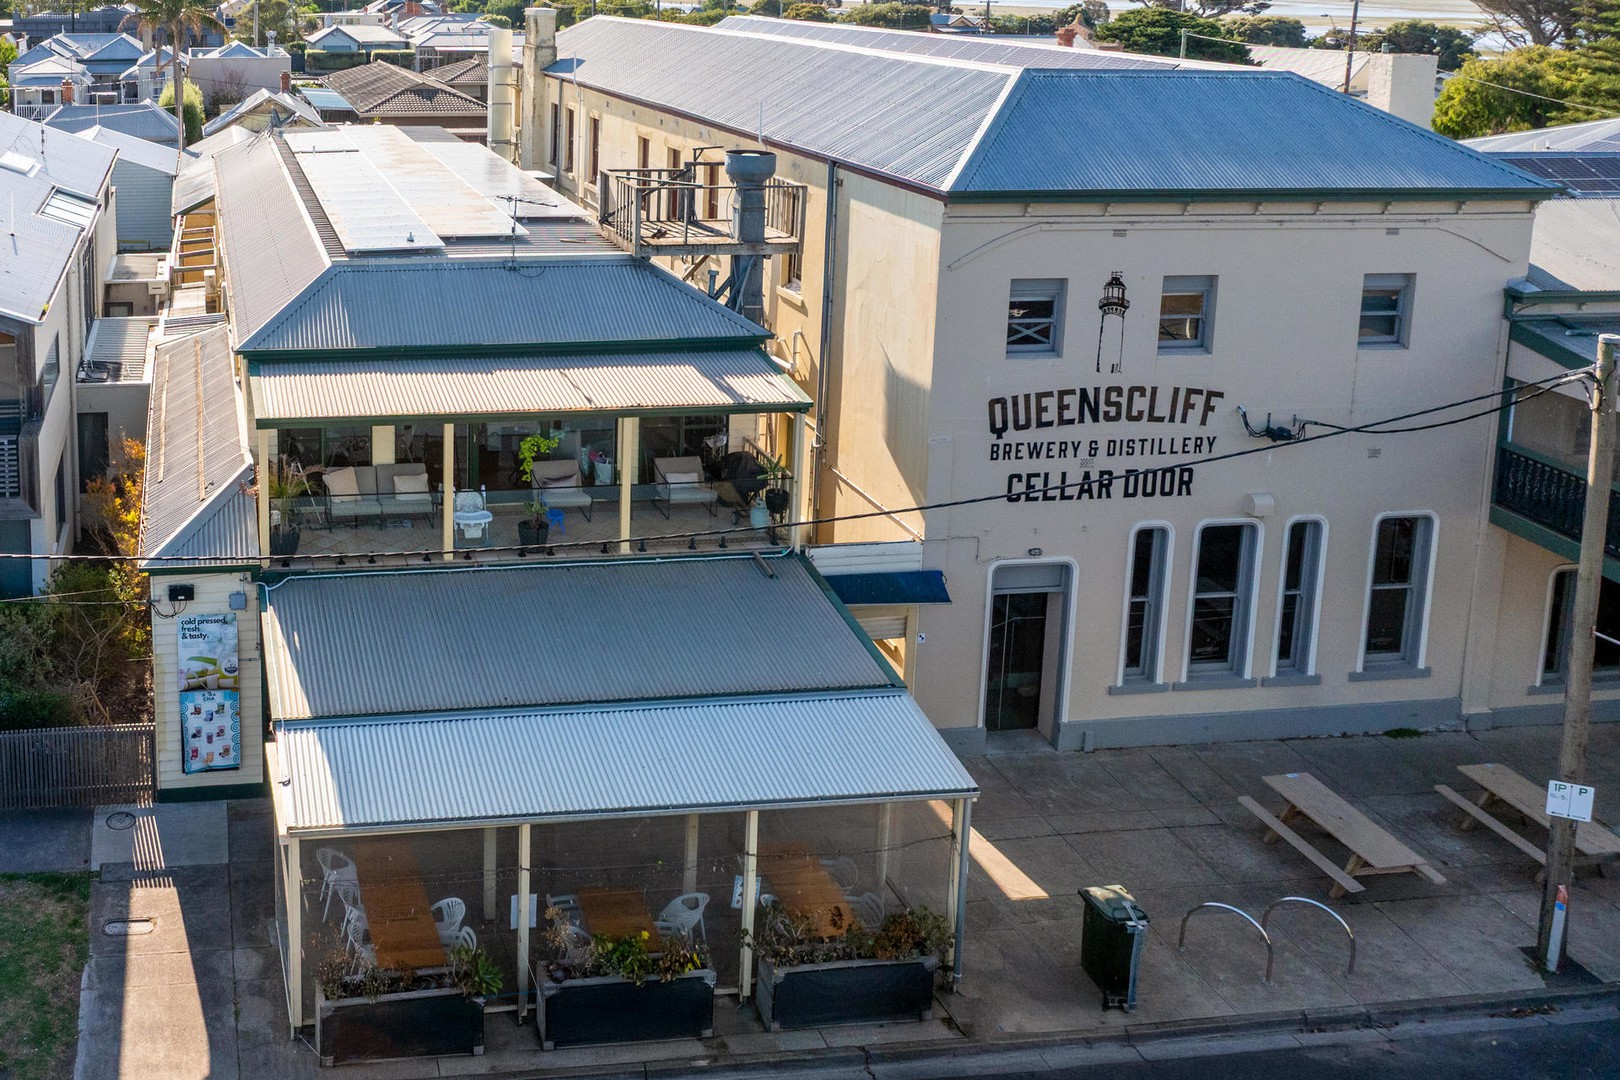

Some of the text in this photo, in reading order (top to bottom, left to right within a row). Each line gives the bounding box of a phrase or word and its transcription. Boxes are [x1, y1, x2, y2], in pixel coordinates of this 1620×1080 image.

[988, 386, 1224, 440] QUEENSCLIFF
[989, 435, 1217, 461] BREWERY & DISTILLERY
[1006, 467, 1194, 503] CELLAR DOOR
[181, 632, 209, 641] & tasty.
[1554, 783, 1567, 792] 1P
[1578, 787, 1588, 796] P
